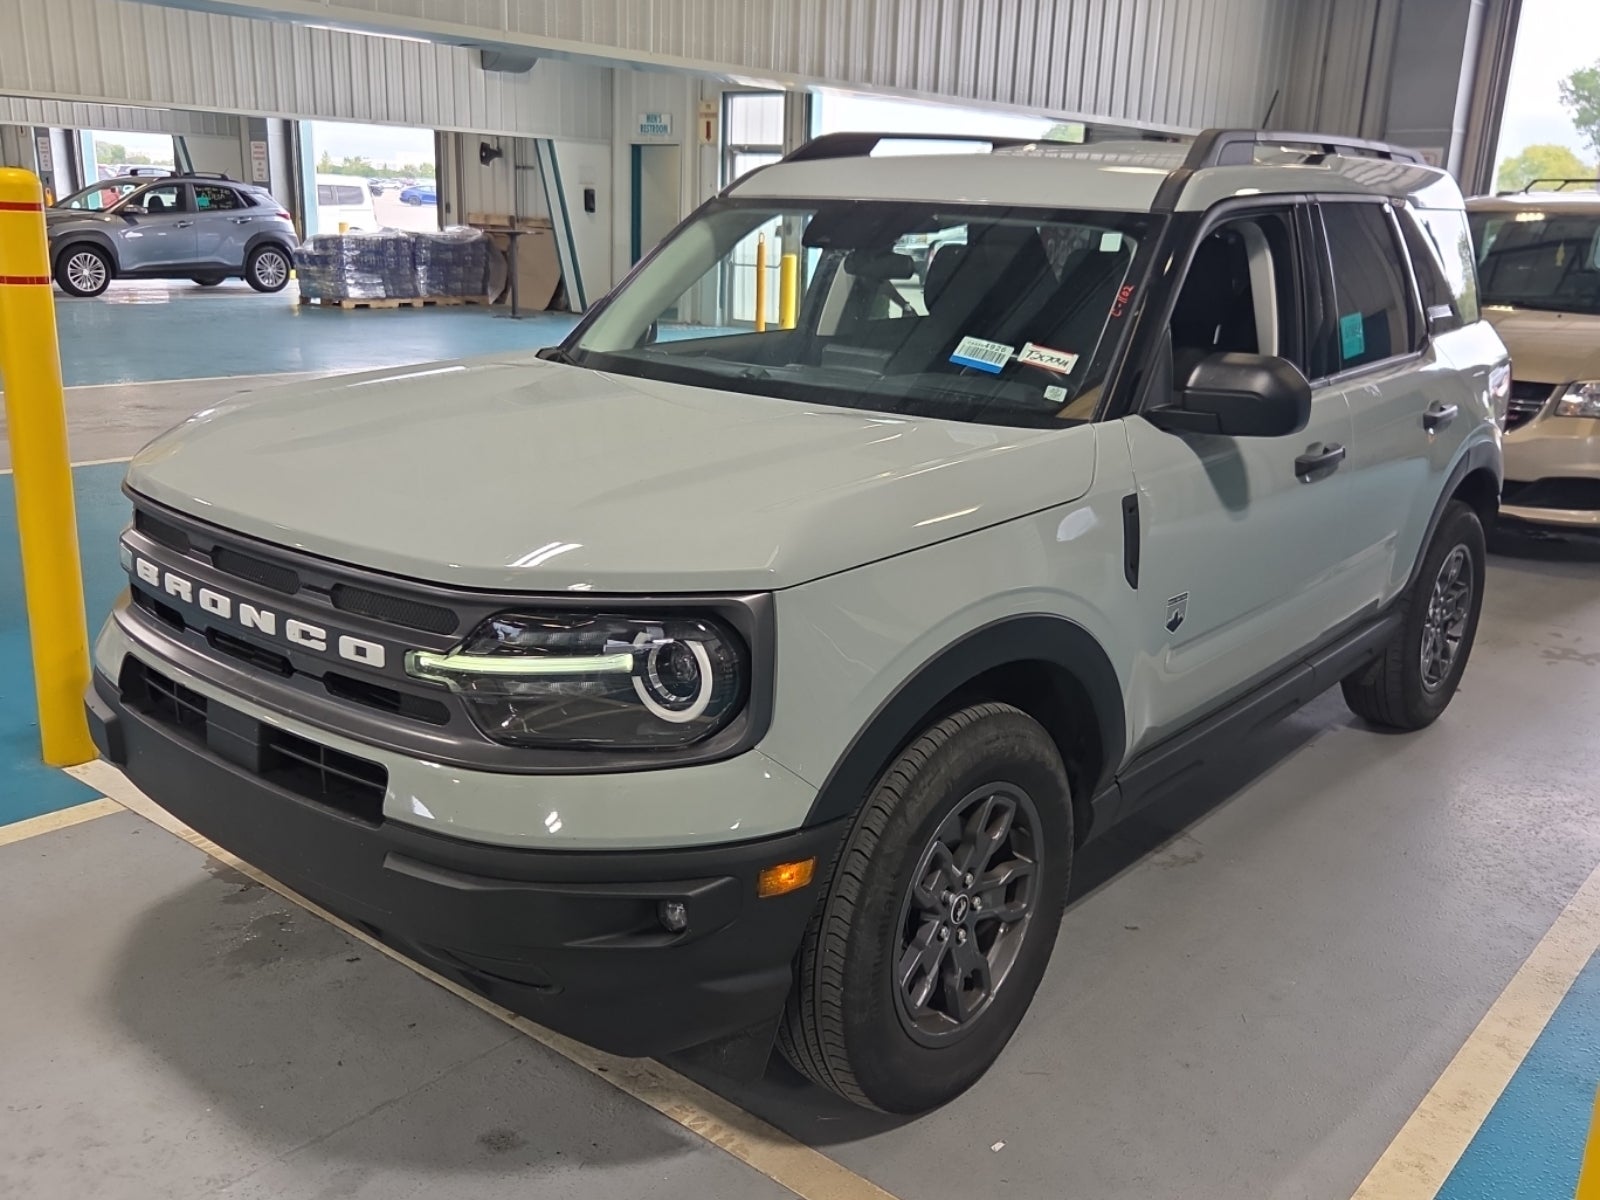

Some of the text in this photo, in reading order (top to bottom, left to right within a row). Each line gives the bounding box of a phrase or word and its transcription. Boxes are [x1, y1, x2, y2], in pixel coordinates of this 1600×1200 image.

[646, 113, 662, 123] MEN'S
[640, 124, 668, 134] RESTROOM
[136, 557, 386, 668] BRONCO
